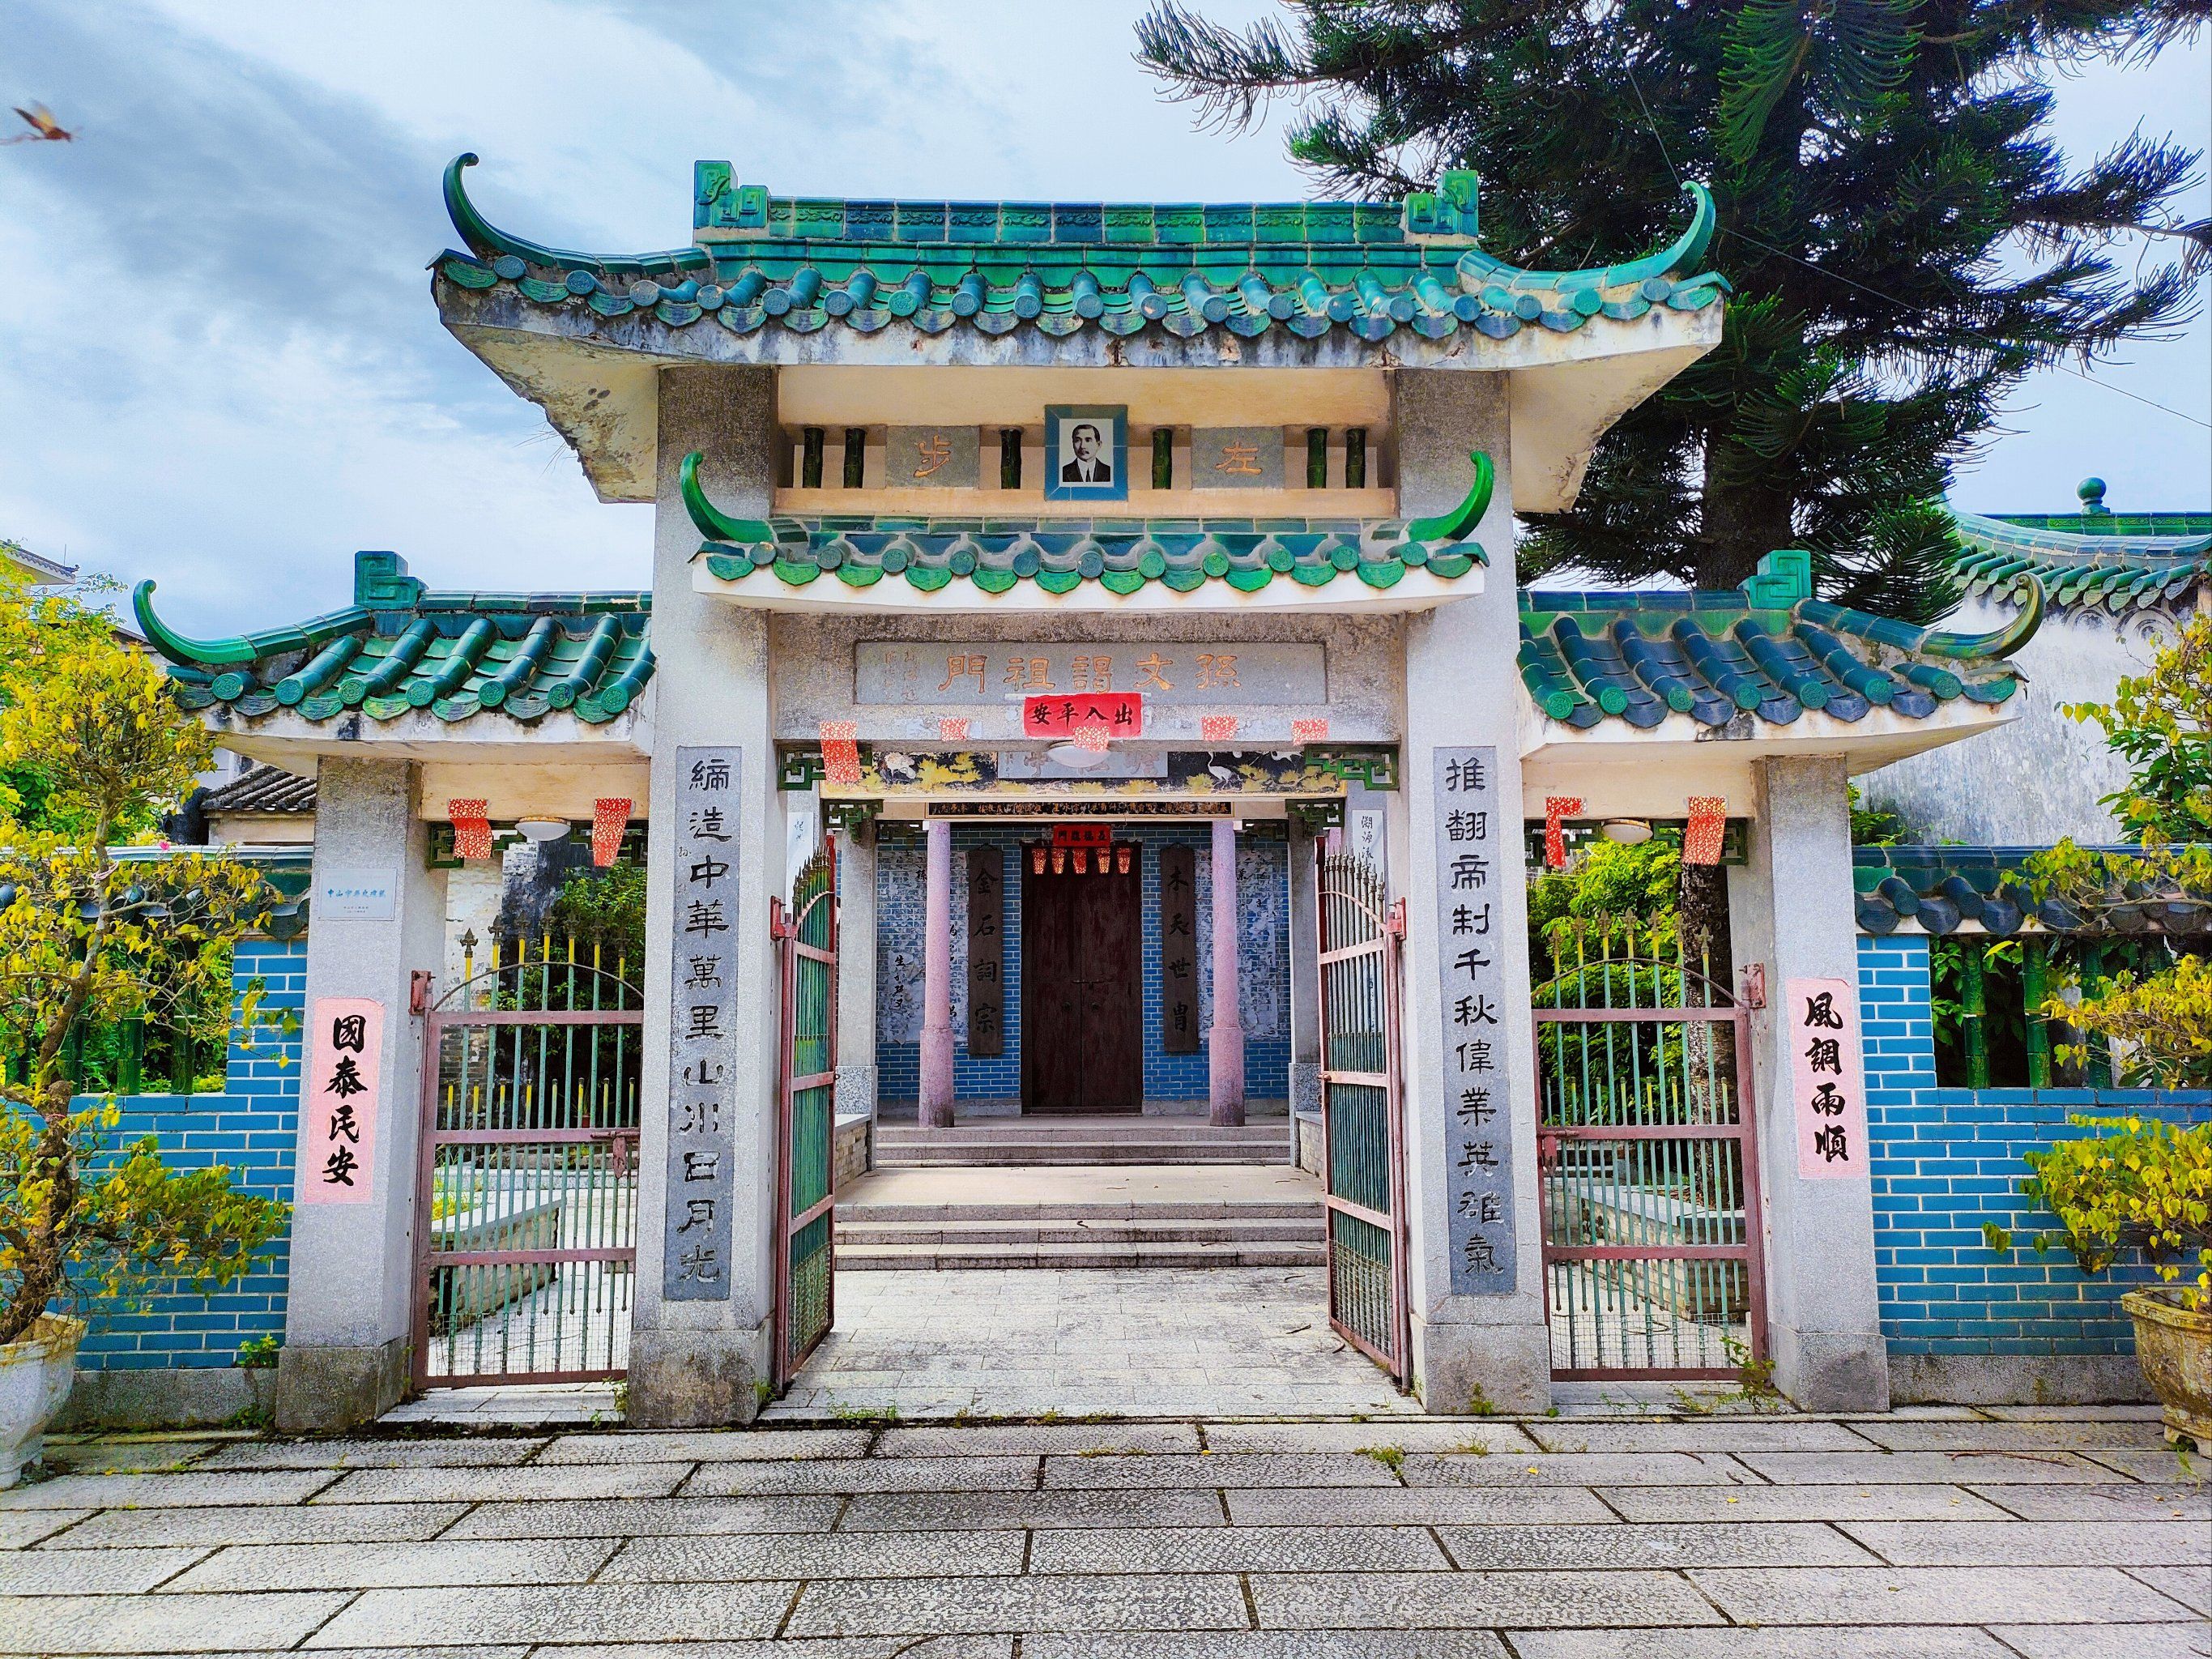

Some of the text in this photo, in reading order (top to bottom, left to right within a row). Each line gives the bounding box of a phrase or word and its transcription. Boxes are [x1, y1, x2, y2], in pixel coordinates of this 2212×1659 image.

[913, 435, 952, 478] 步
[1214, 440, 1264, 476] 左
[1029, 702, 1134, 729] 出入平安
[973, 868, 999, 1034] 金石詞宗
[322, 1014, 369, 1188] 國泰民安
[1803, 991, 1850, 1163] 風調雨順
